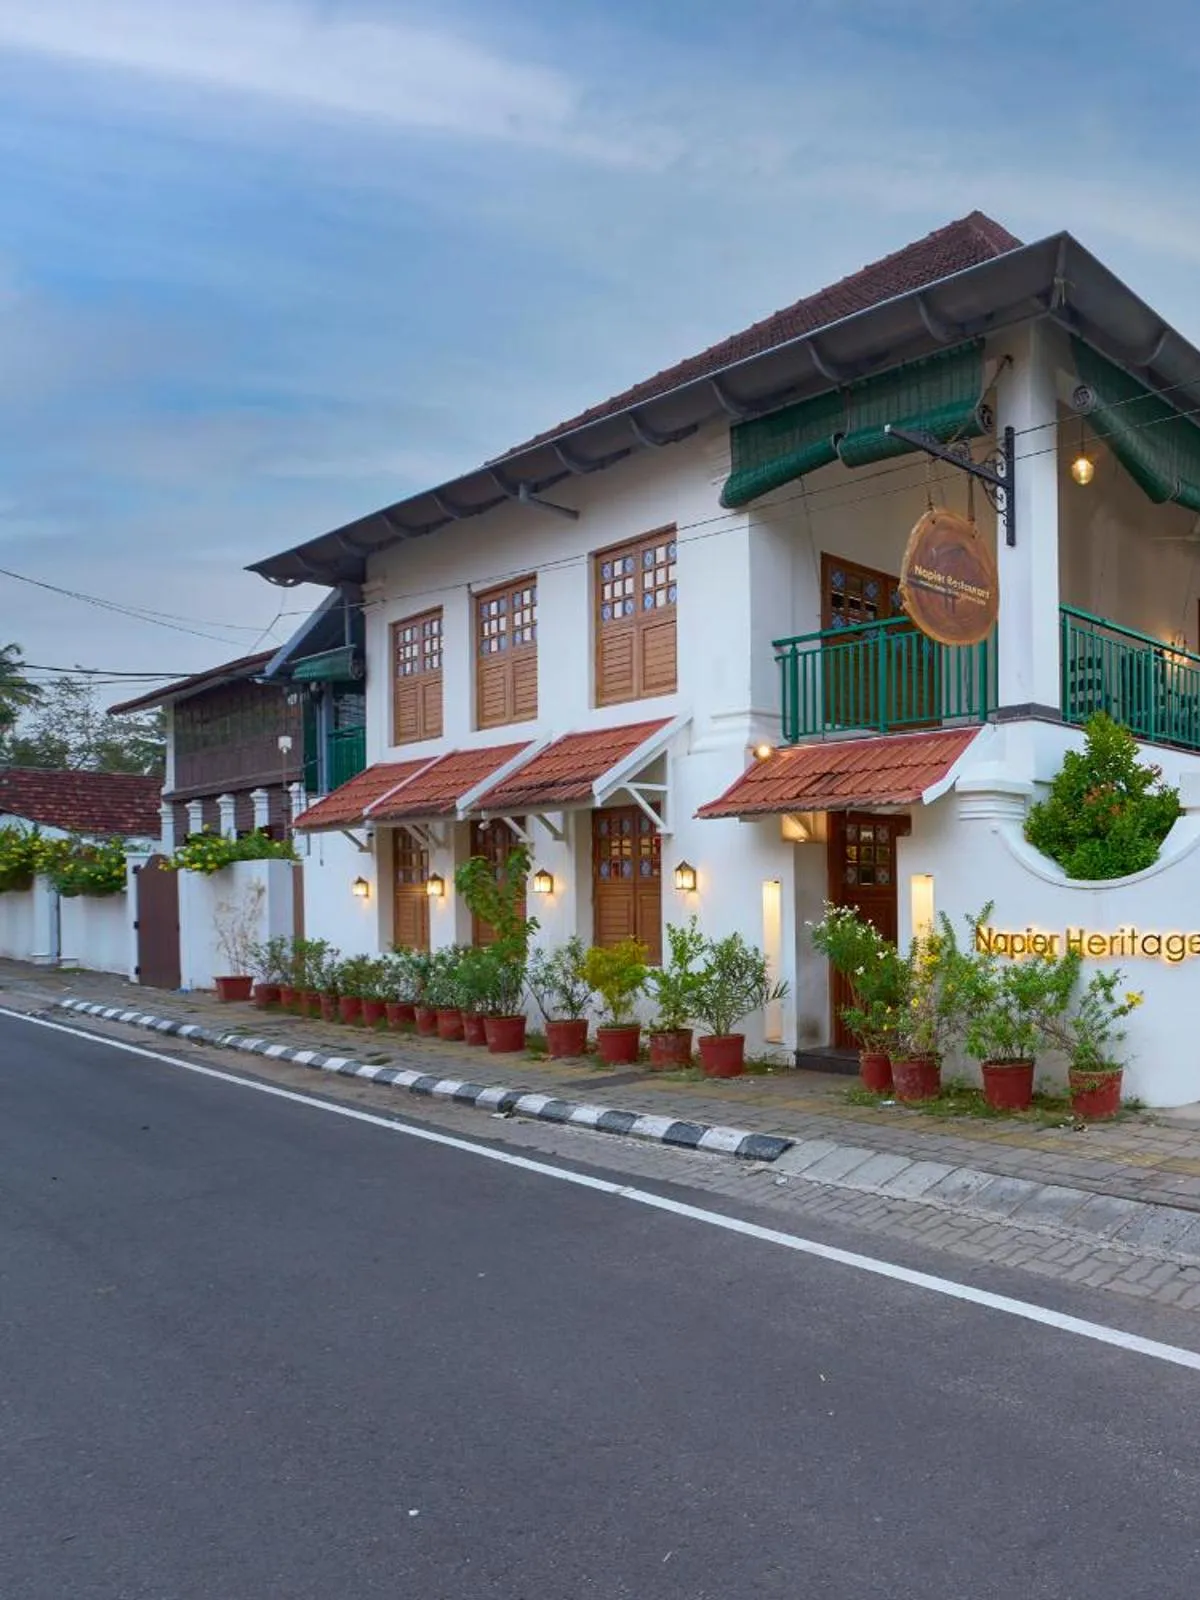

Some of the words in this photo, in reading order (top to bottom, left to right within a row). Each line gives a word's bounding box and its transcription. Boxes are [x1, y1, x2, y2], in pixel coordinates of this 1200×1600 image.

[914, 564, 945, 584] Napier
[946, 575, 990, 600] Restaurant
[975, 927, 1060, 959] Napier
